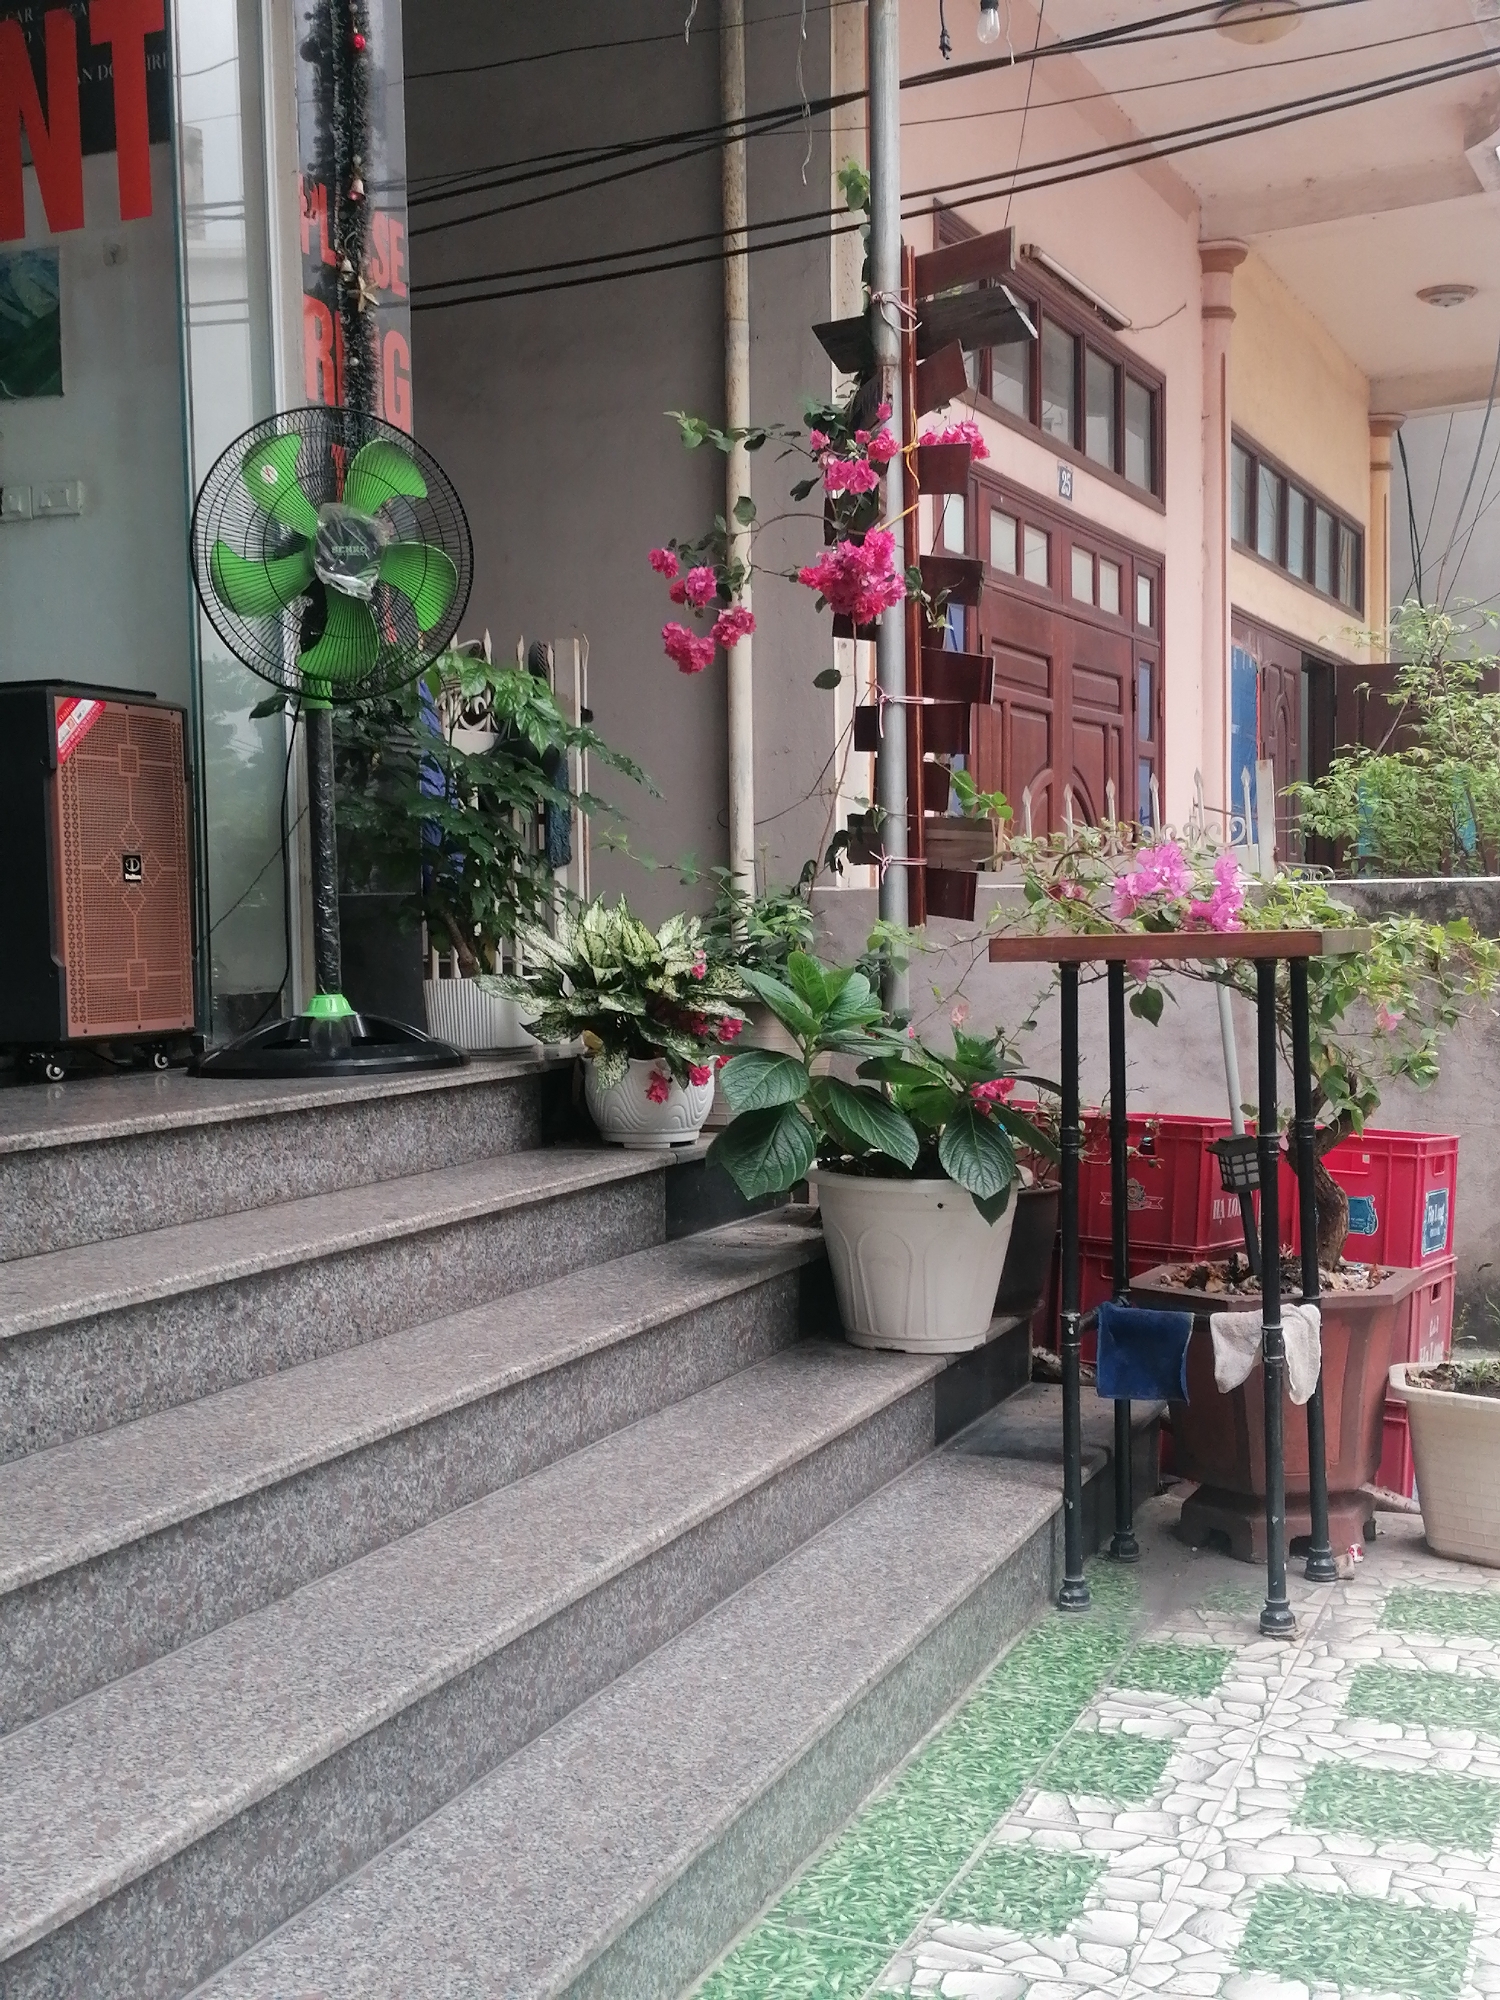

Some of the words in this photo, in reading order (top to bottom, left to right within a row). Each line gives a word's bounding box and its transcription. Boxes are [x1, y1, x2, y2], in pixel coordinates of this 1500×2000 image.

[299, 172, 407, 298] PLSE
[1061, 470, 1071, 497] 25
[1227, 1197, 1242, 1218] LO
